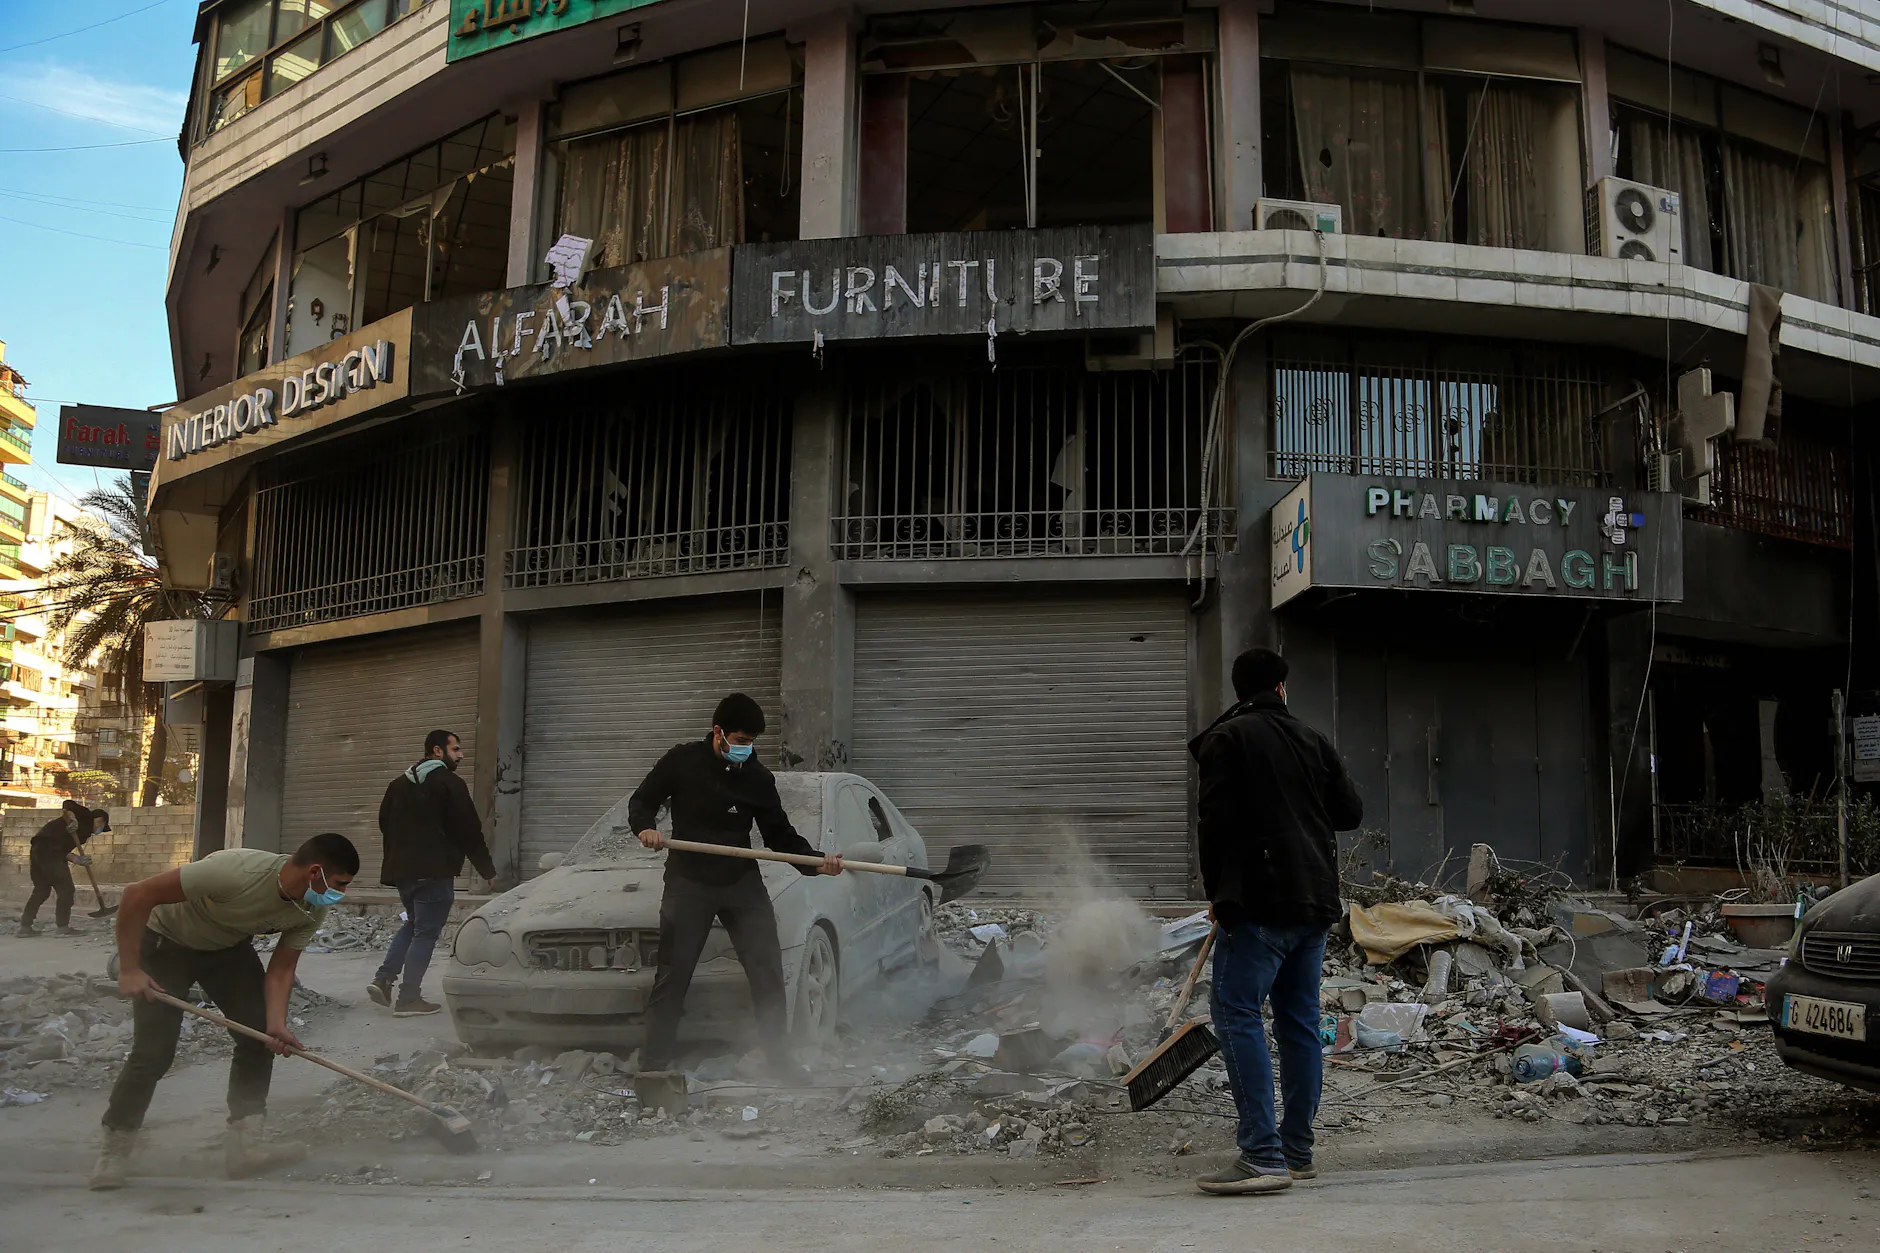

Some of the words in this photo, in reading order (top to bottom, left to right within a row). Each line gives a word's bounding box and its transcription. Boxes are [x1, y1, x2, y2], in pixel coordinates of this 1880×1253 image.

[451, 285, 670, 384] ALFARAH
[166, 387, 274, 461] INTERIOR
[281, 339, 390, 417] DESIGN
[63, 416, 131, 446] Farah
[1366, 486, 1577, 527] PHARMACY
[1367, 537, 1640, 593] SABBAGH
[1805, 1003, 1855, 1036] 424684
